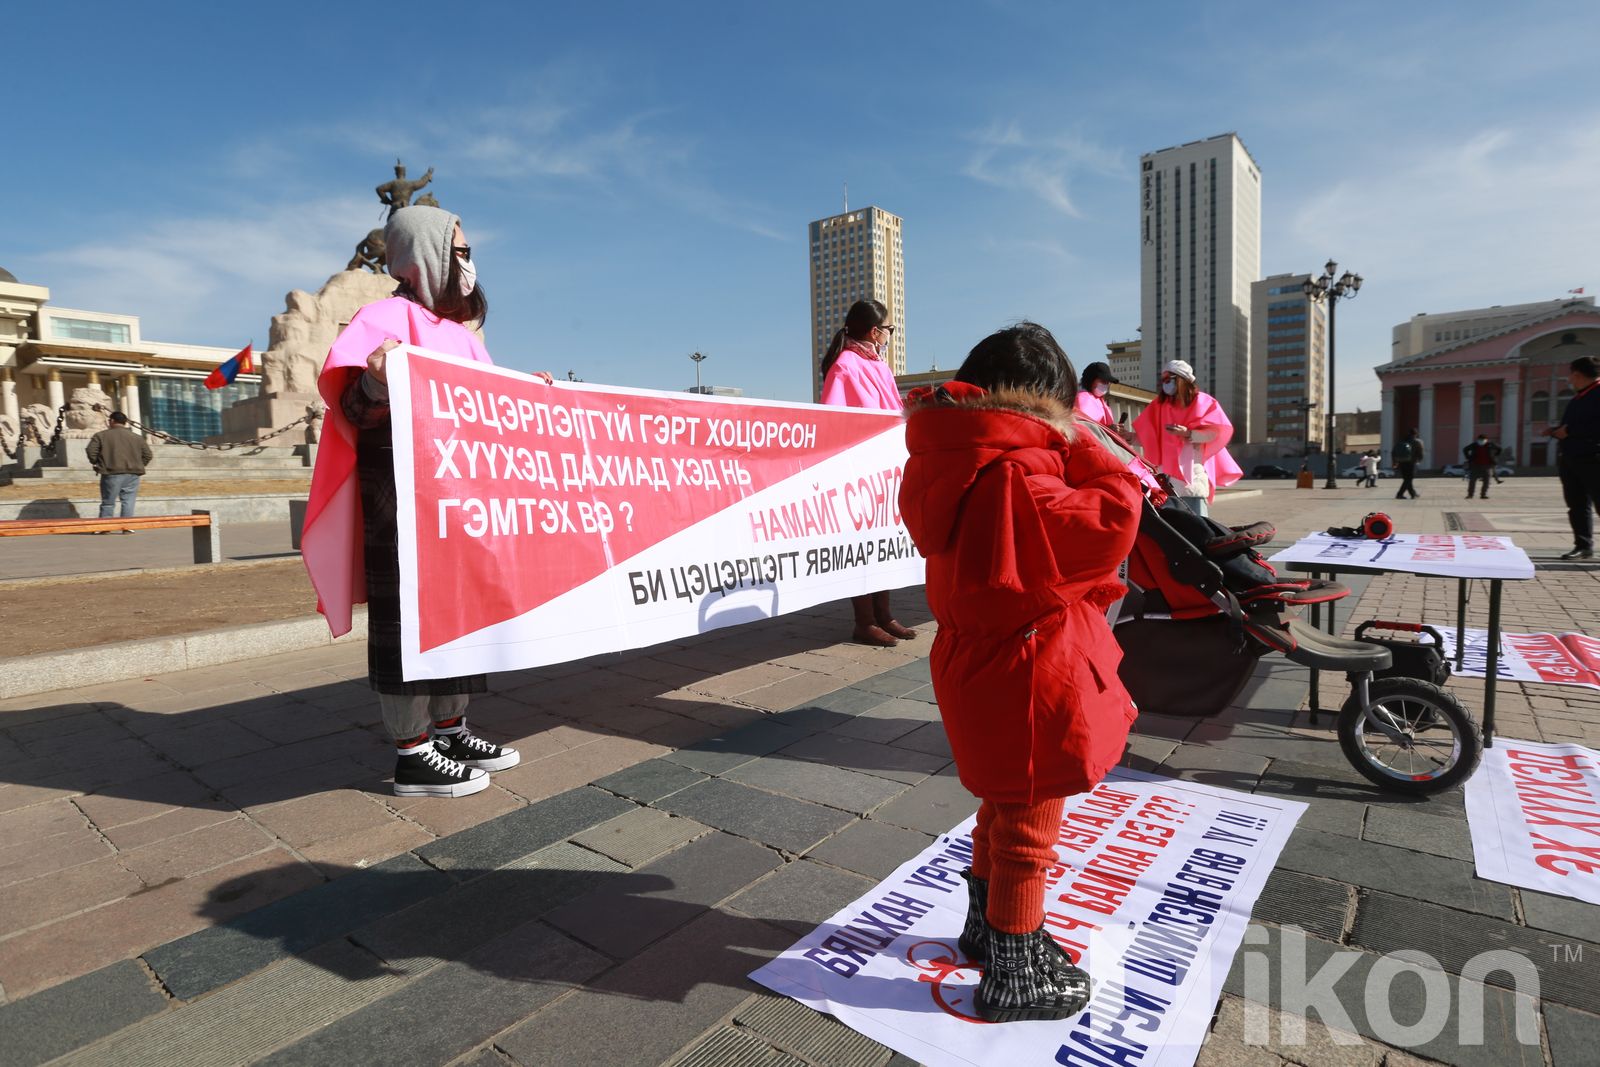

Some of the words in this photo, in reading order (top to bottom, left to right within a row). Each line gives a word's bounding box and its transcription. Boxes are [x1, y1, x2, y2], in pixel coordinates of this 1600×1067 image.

[429, 379, 634, 443] ЦЭЦЭРЛЭГГҮЙ
[639, 414, 700, 445] ГЭРТ
[705, 418, 817, 452] ХОЦОРСОН
[434, 439, 559, 492] ХҮҮХЭД
[561, 453, 671, 492] ДАХИАД
[671, 457, 721, 490] ХЭД
[720, 460, 751, 486] НЬ
[438, 498, 577, 538] ГЭМТЭХ
[619, 501, 634, 531] ?
[749, 482, 841, 543] НАМАЙГ
[628, 569, 667, 605] БИ
[670, 551, 799, 603] ЦЭЦЭРЛЭГТ
[806, 541, 874, 577] ЯВМААР
[802, 891, 935, 979] БЯЦХАН
[903, 834, 973, 893] ҮРСИЙ
[1057, 844, 1159, 915] БАЙГАА
[1116, 882, 1224, 986] ШИЙДЭЖ
[1175, 848, 1247, 891] ӨГНӨ
